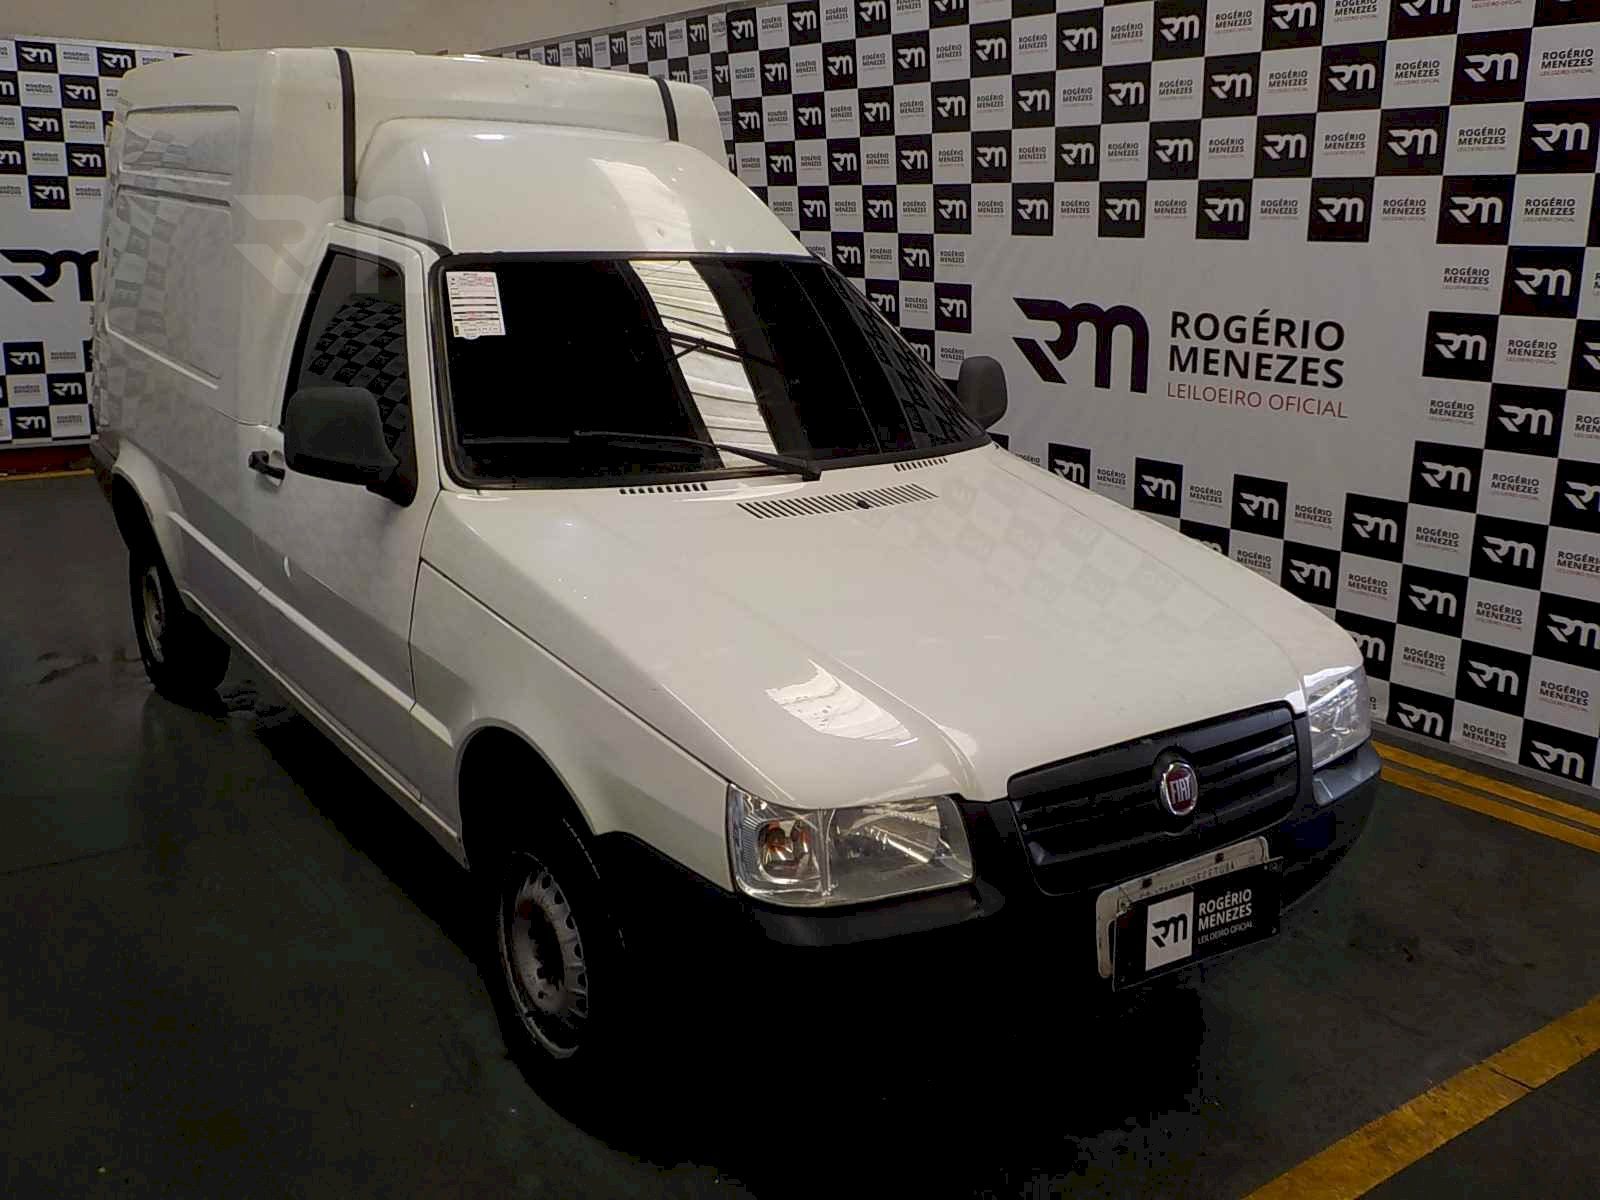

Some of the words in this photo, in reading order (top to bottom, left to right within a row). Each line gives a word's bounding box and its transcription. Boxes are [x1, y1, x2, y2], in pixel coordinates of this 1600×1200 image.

[1215, 9, 1252, 21] ROGÉRIO
[1334, 4, 1377, 16] MENEZES
[1215, 17, 1252, 29] MENEZES
[1542, 47, 1594, 60] ROGÉRIO
[1395, 59, 1440, 71] ROGÉRIO
[1541, 57, 1593, 69] MENEZES
[1269, 69, 1308, 80] ROGÉRIO
[1394, 68, 1440, 79] MENEZES
[1268, 78, 1307, 88] MENEZES
[1325, 131, 1366, 141] ROGÉRIO
[1459, 126, 1506, 137] ROGÉRIO
[1209, 136, 1244, 146] ROGÉRIO
[1324, 141, 1365, 149] MENEZES
[1458, 136, 1506, 145] MENEZES
[1208, 145, 1244, 153] MENEZES
[1261, 198, 1298, 207] ROGÉRIO
[1383, 197, 1427, 206] ROGÉRIO
[1525, 196, 1576, 206] ROGÉRIO
[1524, 207, 1575, 215] MENEZES
[1444, 266, 1490, 276] ROGÉRIO
[1443, 276, 1490, 284] MENEZES
[1171, 308, 1345, 351] ROGÉRIO
[1508, 338, 1557, 350] ROGÉRIO
[1507, 347, 1556, 358] MENEZES
[1168, 345, 1345, 389] MENEZES
[1167, 381, 1262, 407] LEILOEIRO
[1268, 394, 1348, 418] OFICIAL
[1430, 399, 1475, 411] ROGÉRIO
[1429, 407, 1474, 419] MENEZES
[1492, 473, 1539, 486] ROGÉRIO
[1189, 485, 1222, 497] ROGÉRIO
[1491, 481, 1539, 495] MENEZES
[1189, 491, 1222, 503] MENEZES
[1295, 504, 1332, 517] ROGÉRIO
[1294, 511, 1332, 524] MENEZES
[1416, 526, 1459, 540] ROGÉRIO
[1415, 533, 1459, 548] MENEZES
[1237, 549, 1271, 562] ROGÉRIO
[1557, 550, 1600, 566] ROGÉRI
[1236, 556, 1271, 569] MENEZES
[1348, 573, 1388, 588] ROGÉRIO
[1347, 580, 1387, 595] MENEZES
[1477, 600, 1523, 617] ROGÉRIO
[1476, 608, 1522, 625] MENEZES
[1404, 645, 1445, 662] ROGÉRIO
[1403, 653, 1445, 670] MENEZES
[1541, 680, 1589, 698] ROGÉRIO
[1540, 688, 1588, 706] MENEZES
[1462, 722, 1507, 741] ROGÉRIO
[1462, 730, 1506, 748] MENEZES
[1169, 774, 1191, 804] FIAT
[1199, 888, 1252, 916] ROGÉRIO
[1198, 903, 1252, 931] MENEZES
